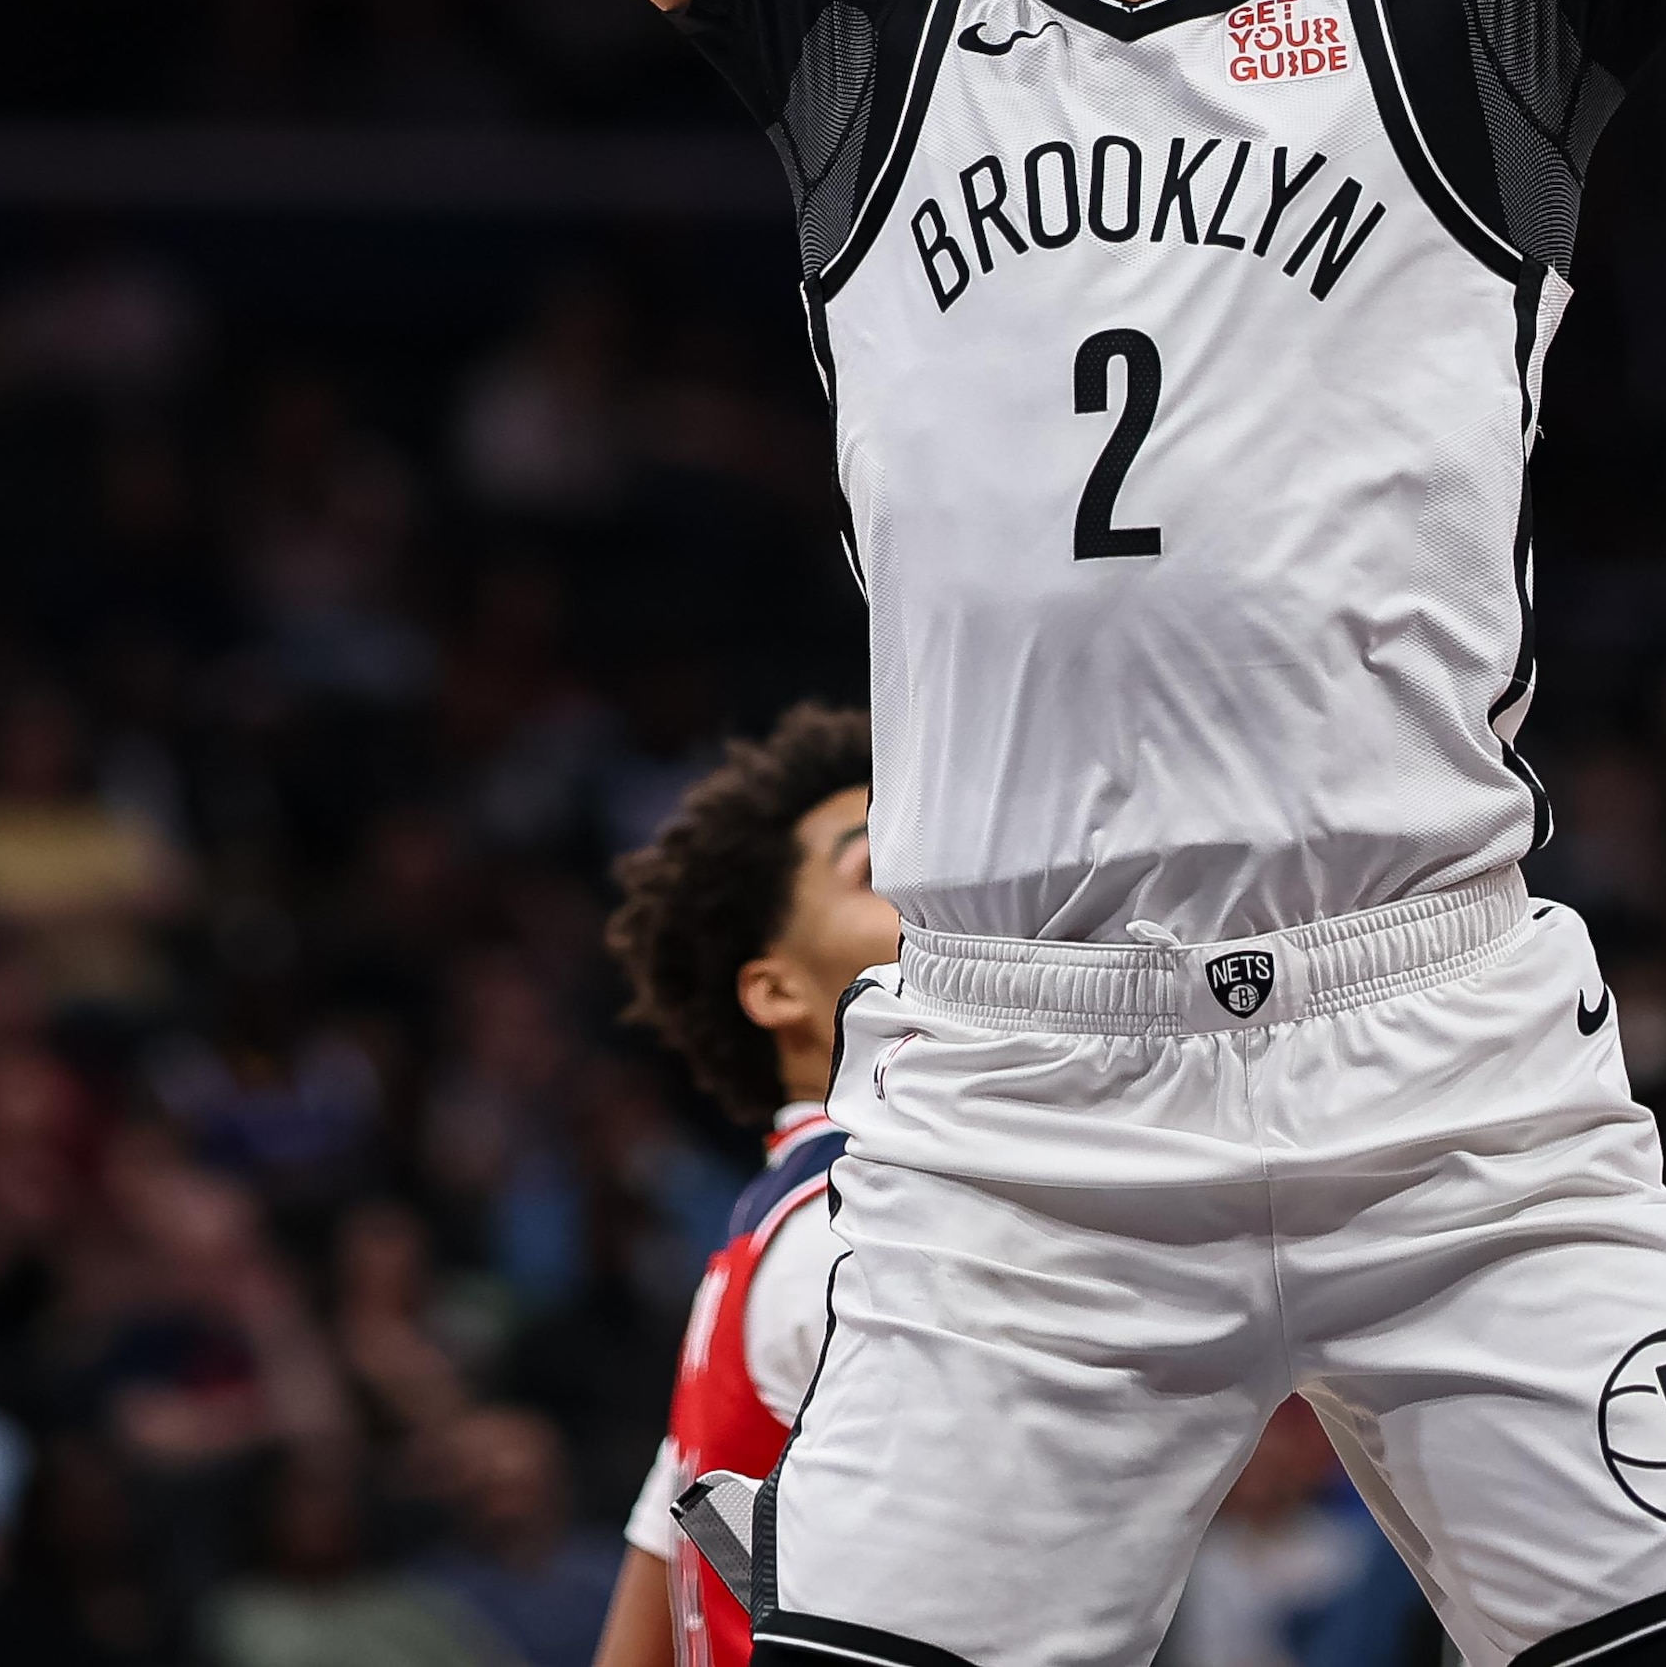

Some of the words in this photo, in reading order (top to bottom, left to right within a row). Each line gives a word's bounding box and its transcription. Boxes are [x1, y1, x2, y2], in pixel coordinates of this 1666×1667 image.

[1228, 17, 1340, 53] YOUR
[1230, 45, 1348, 81] GUIDE
[910, 135, 1386, 313] BROOKLYN
[1073, 328, 1162, 561] 2
[1212, 955, 1270, 989] NETS
